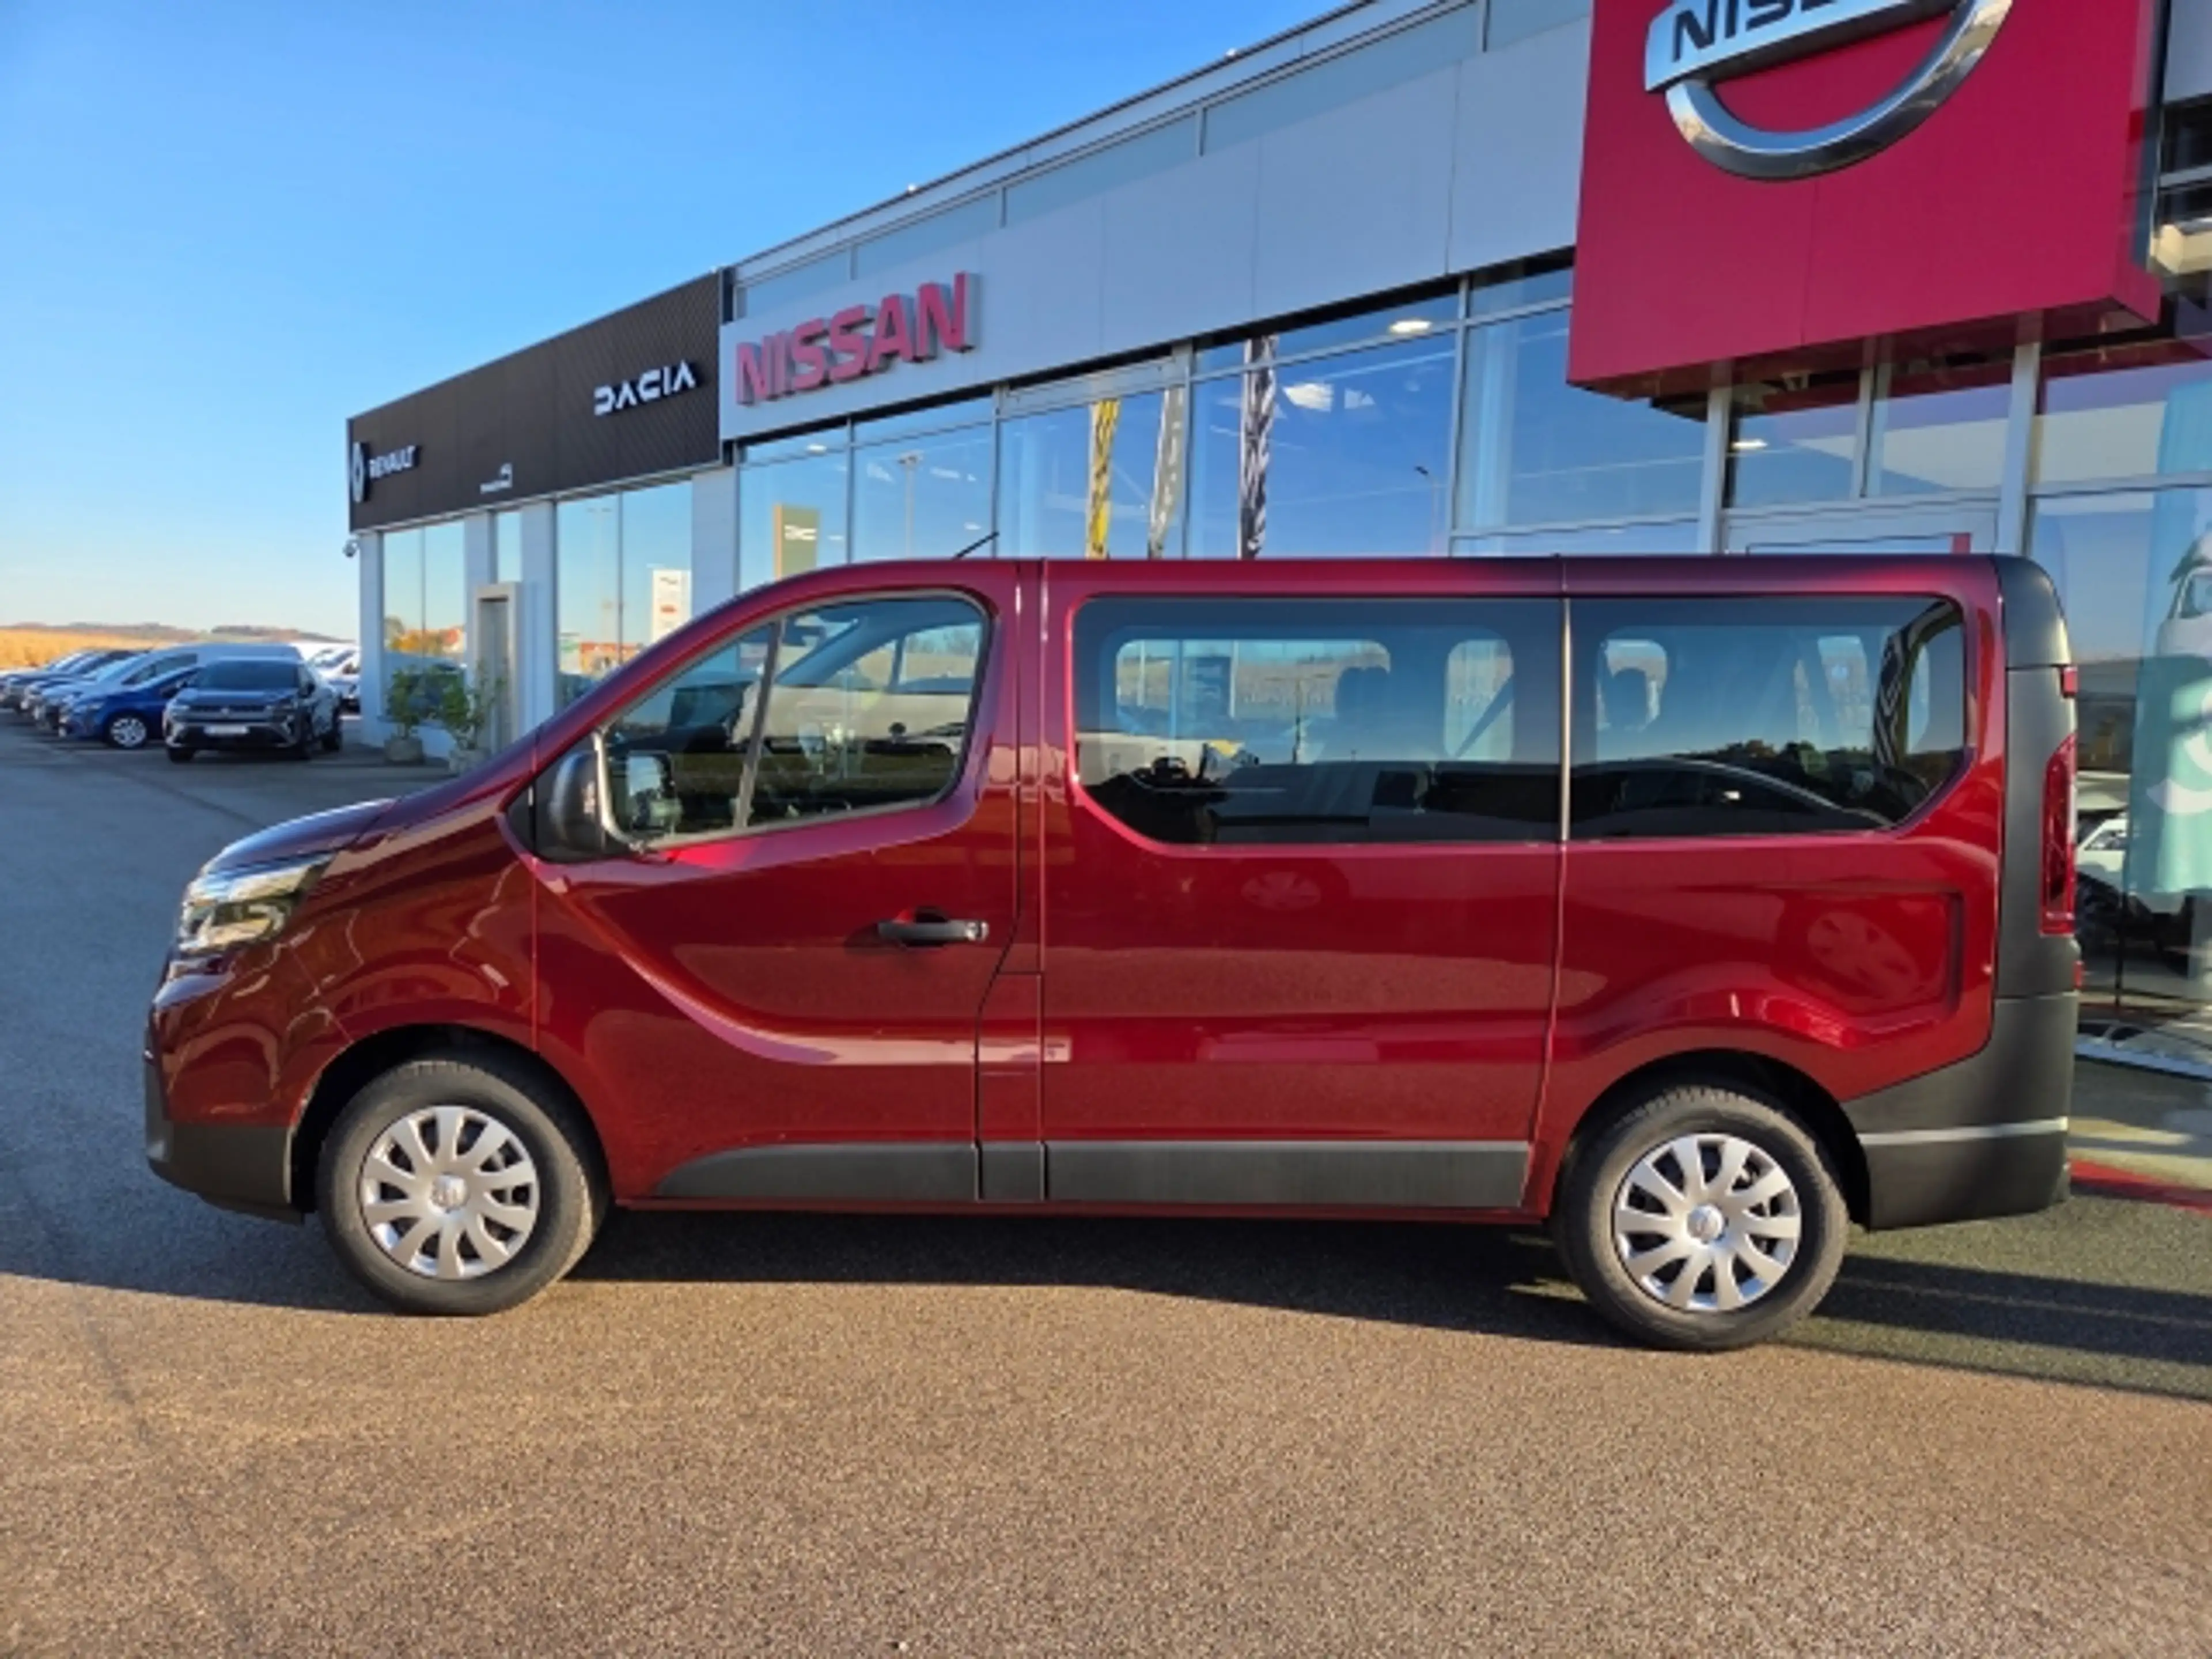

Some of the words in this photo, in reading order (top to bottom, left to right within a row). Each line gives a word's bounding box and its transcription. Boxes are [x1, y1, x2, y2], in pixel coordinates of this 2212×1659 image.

[1672, 0, 1839, 62] NIS
[736, 271, 979, 406] NISSAN
[593, 359, 696, 416] DACIA
[369, 445, 416, 479] RENAULT
